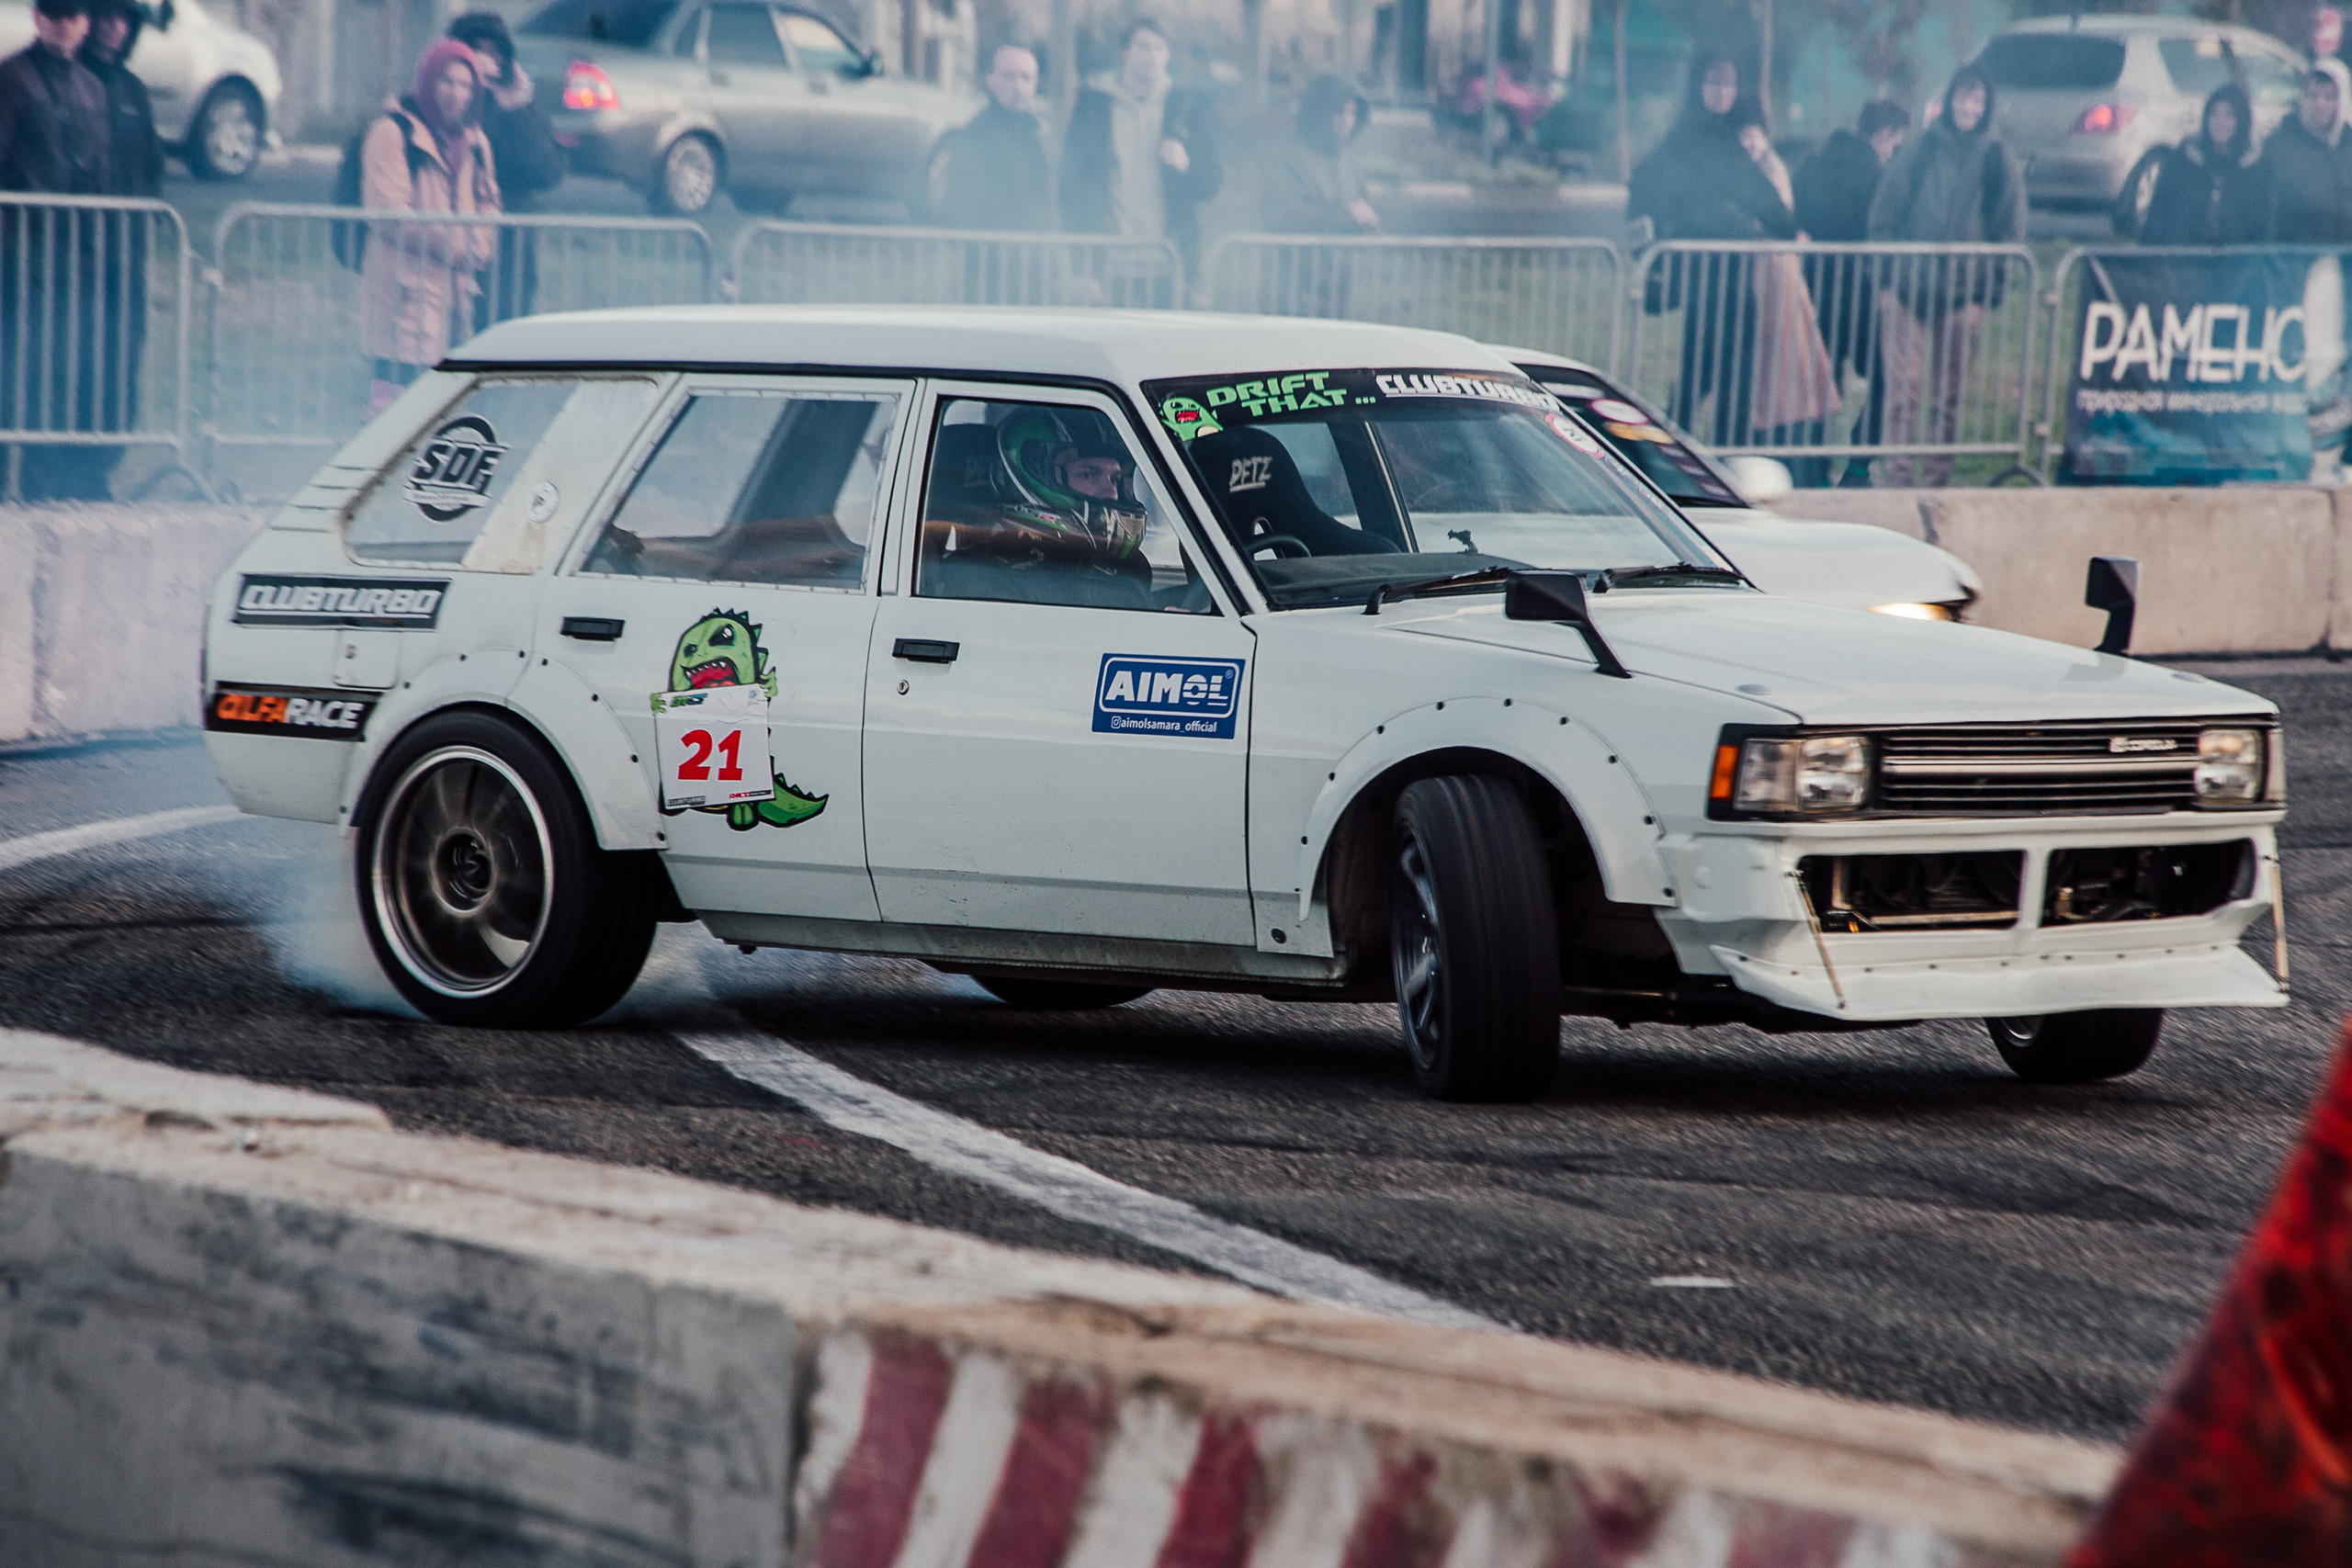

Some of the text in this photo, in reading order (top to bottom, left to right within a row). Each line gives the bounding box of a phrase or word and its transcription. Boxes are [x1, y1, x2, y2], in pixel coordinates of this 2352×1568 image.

[1206, 371, 1329, 407] DRIFT
[1376, 375, 1560, 411] CLUBTURBO
[238, 584, 443, 617] CLUBTURBO
[1104, 670, 1229, 706] AIMOL
[677, 728, 743, 781] 21
